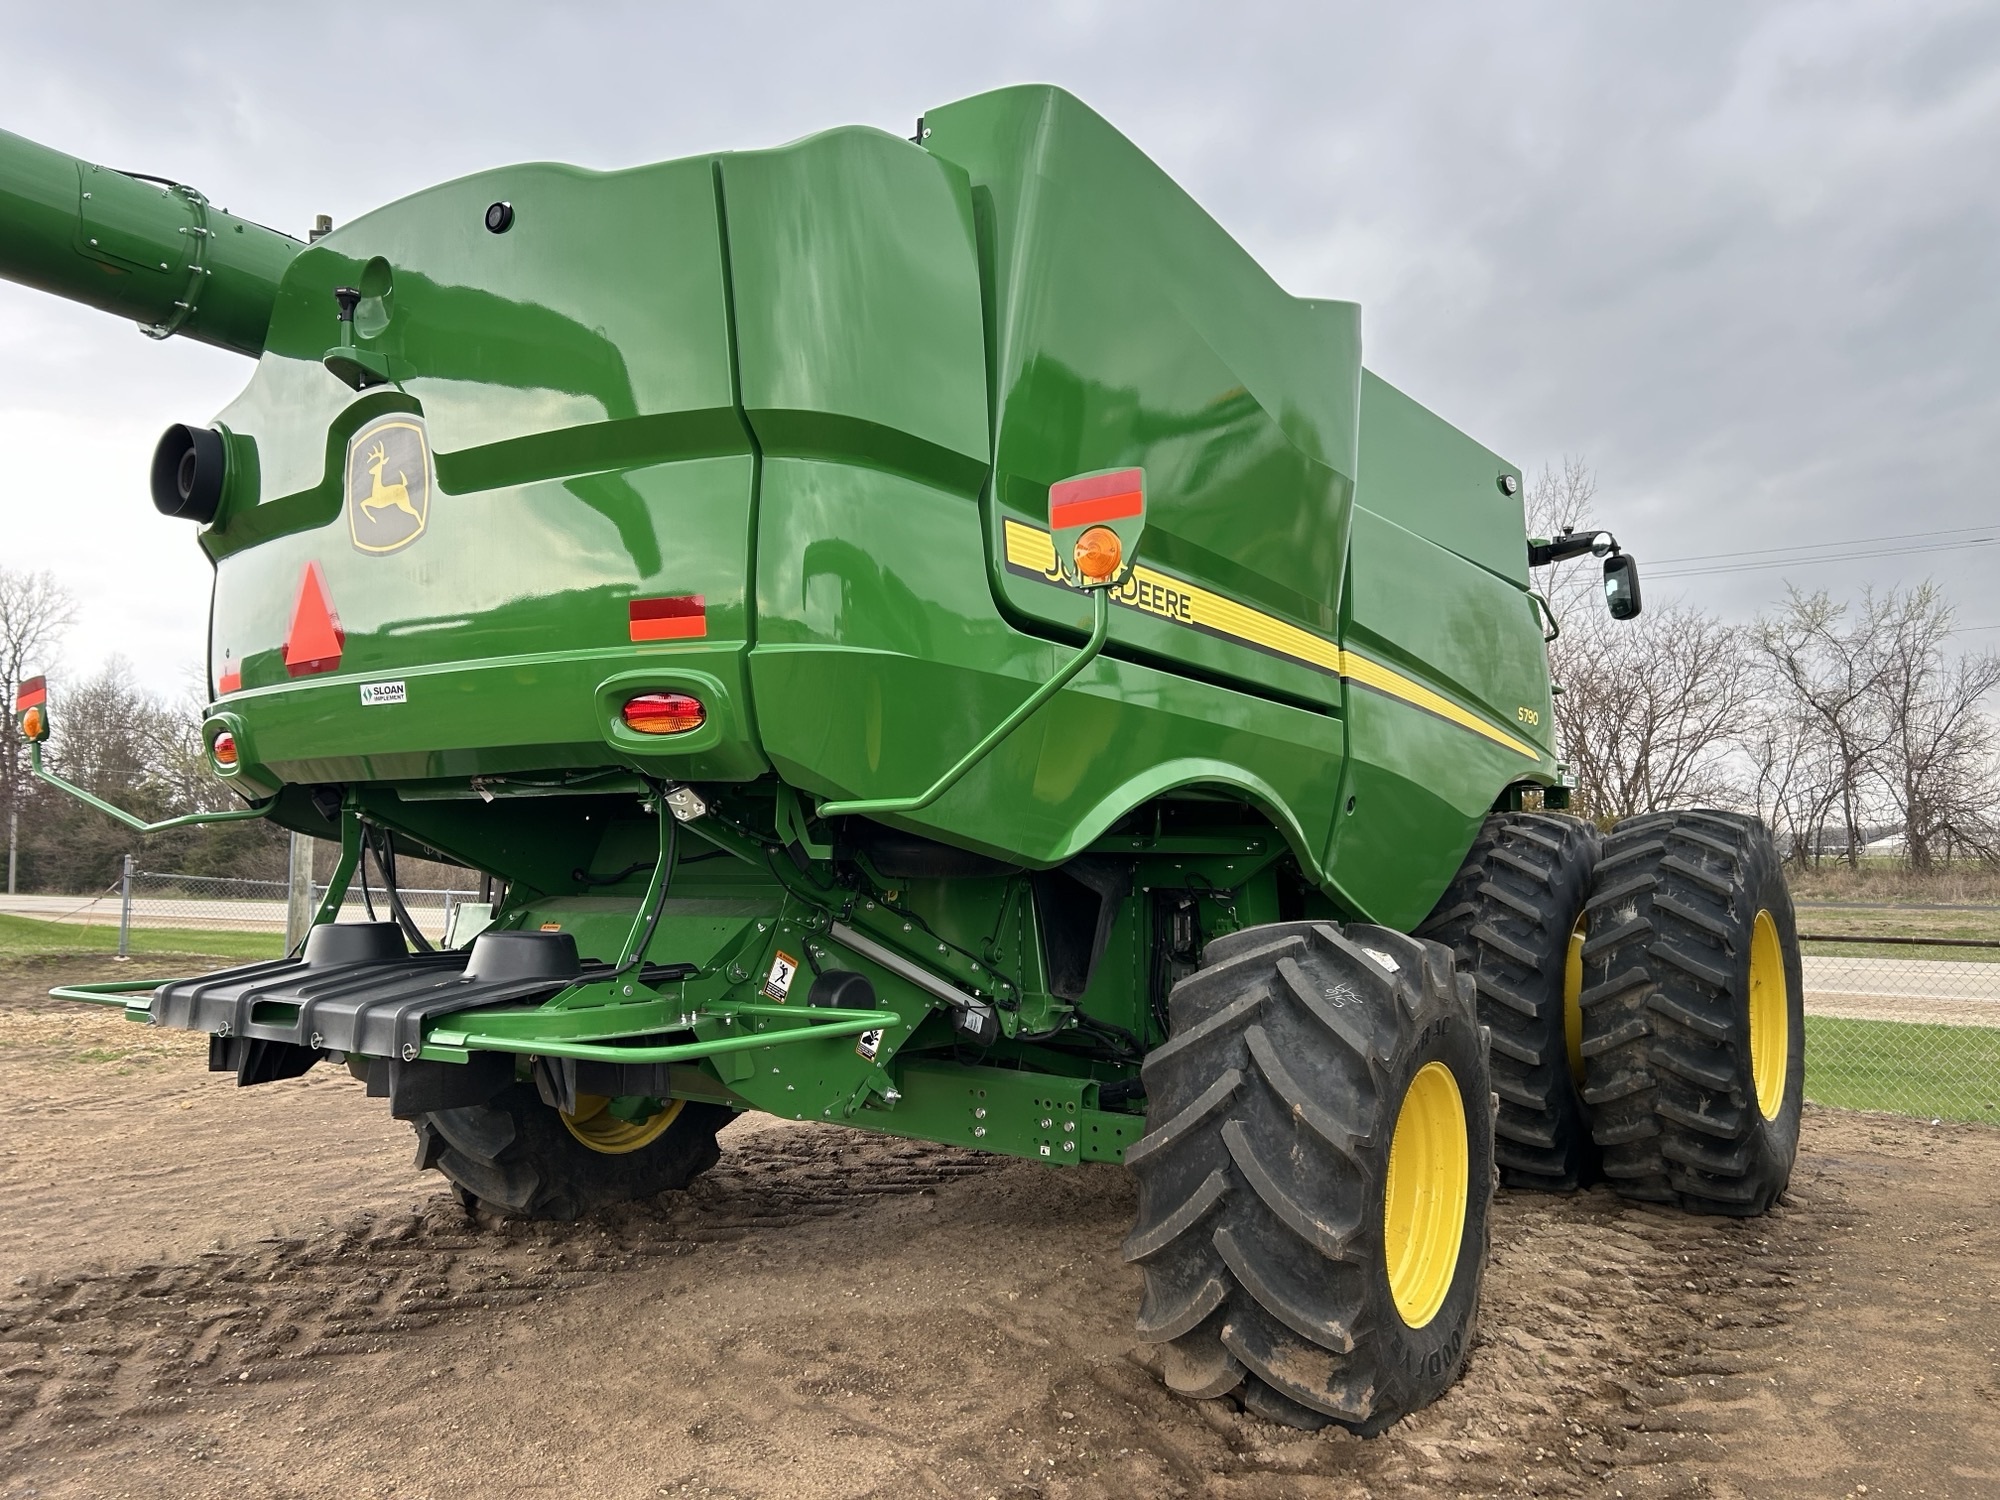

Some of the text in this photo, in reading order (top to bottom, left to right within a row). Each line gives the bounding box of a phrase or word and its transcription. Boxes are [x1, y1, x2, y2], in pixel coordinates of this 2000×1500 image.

[1120, 568, 1192, 620] DEERE
[373, 684, 404, 696] SLOAN
[374, 693, 405, 702] IMPLEMENT
[1518, 706, 1539, 726] S790
